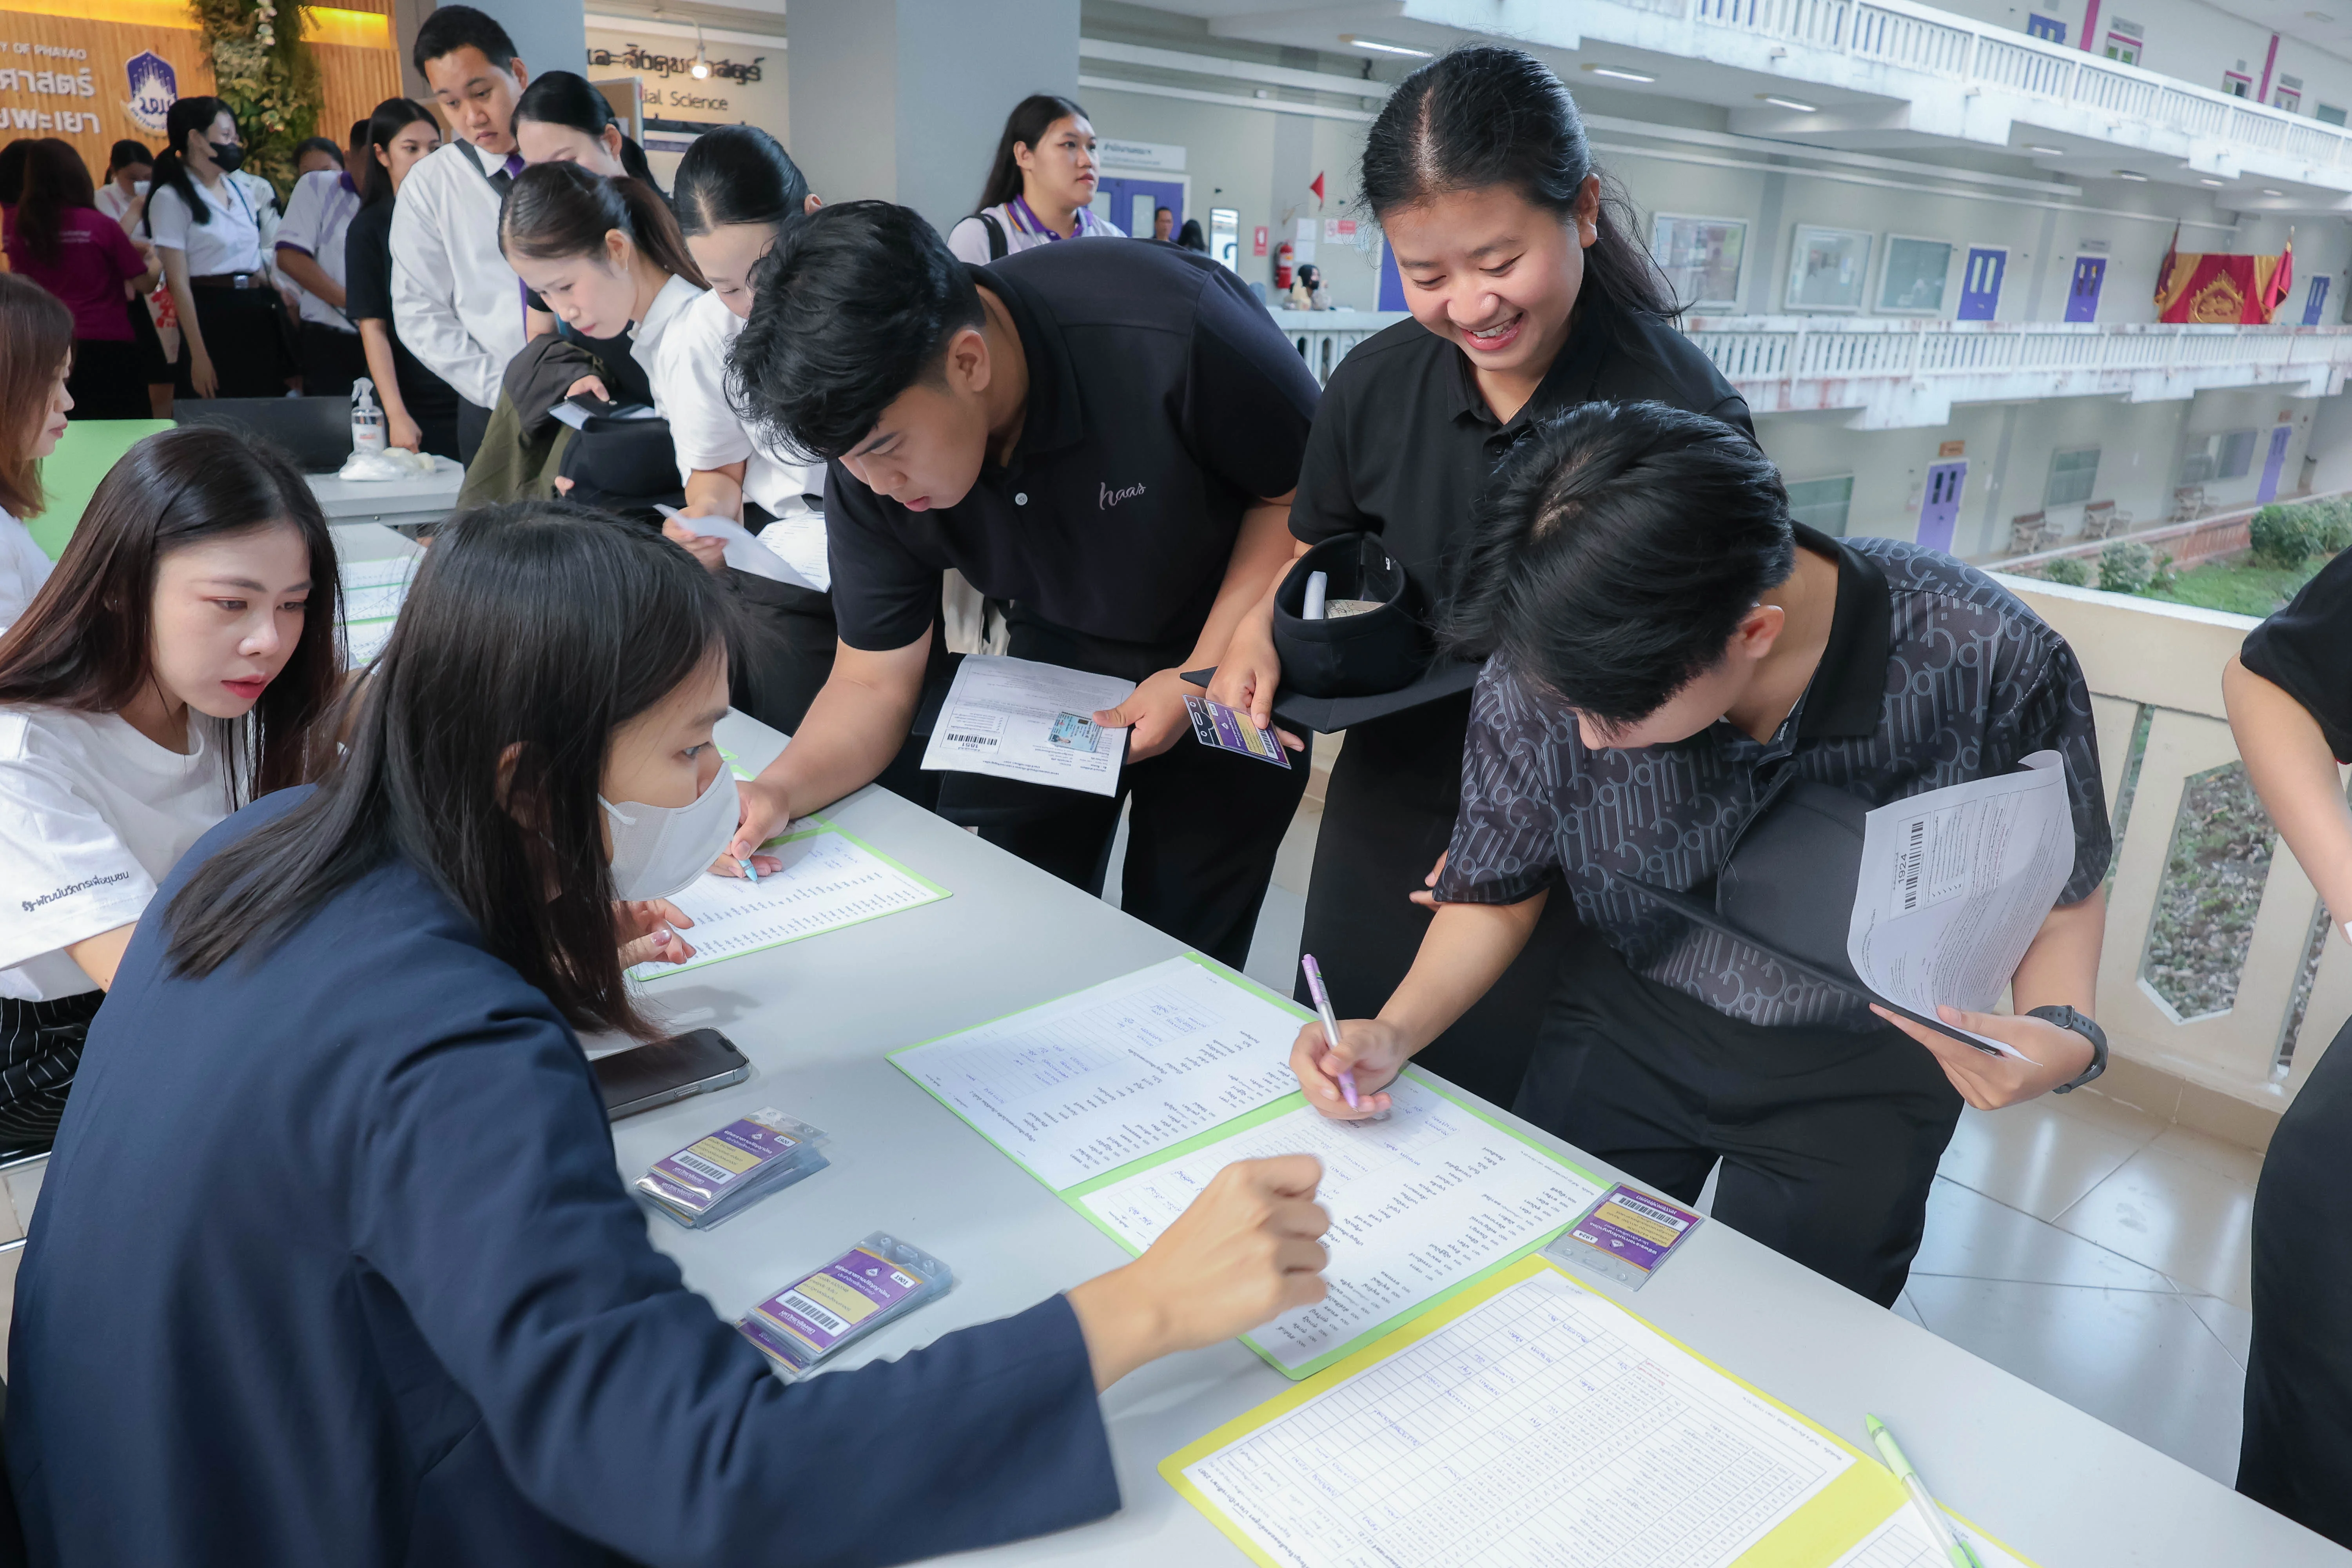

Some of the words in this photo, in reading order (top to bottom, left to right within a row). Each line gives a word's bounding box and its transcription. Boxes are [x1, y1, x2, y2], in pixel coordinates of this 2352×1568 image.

[13, 42, 31, 54] OF
[670, 91, 728, 111] Science
[1099, 482, 1147, 510] haas
[1897, 853, 1908, 884] 1924
[1579, 1232, 1594, 1242] 1924
[894, 1273, 909, 1286] 1901
